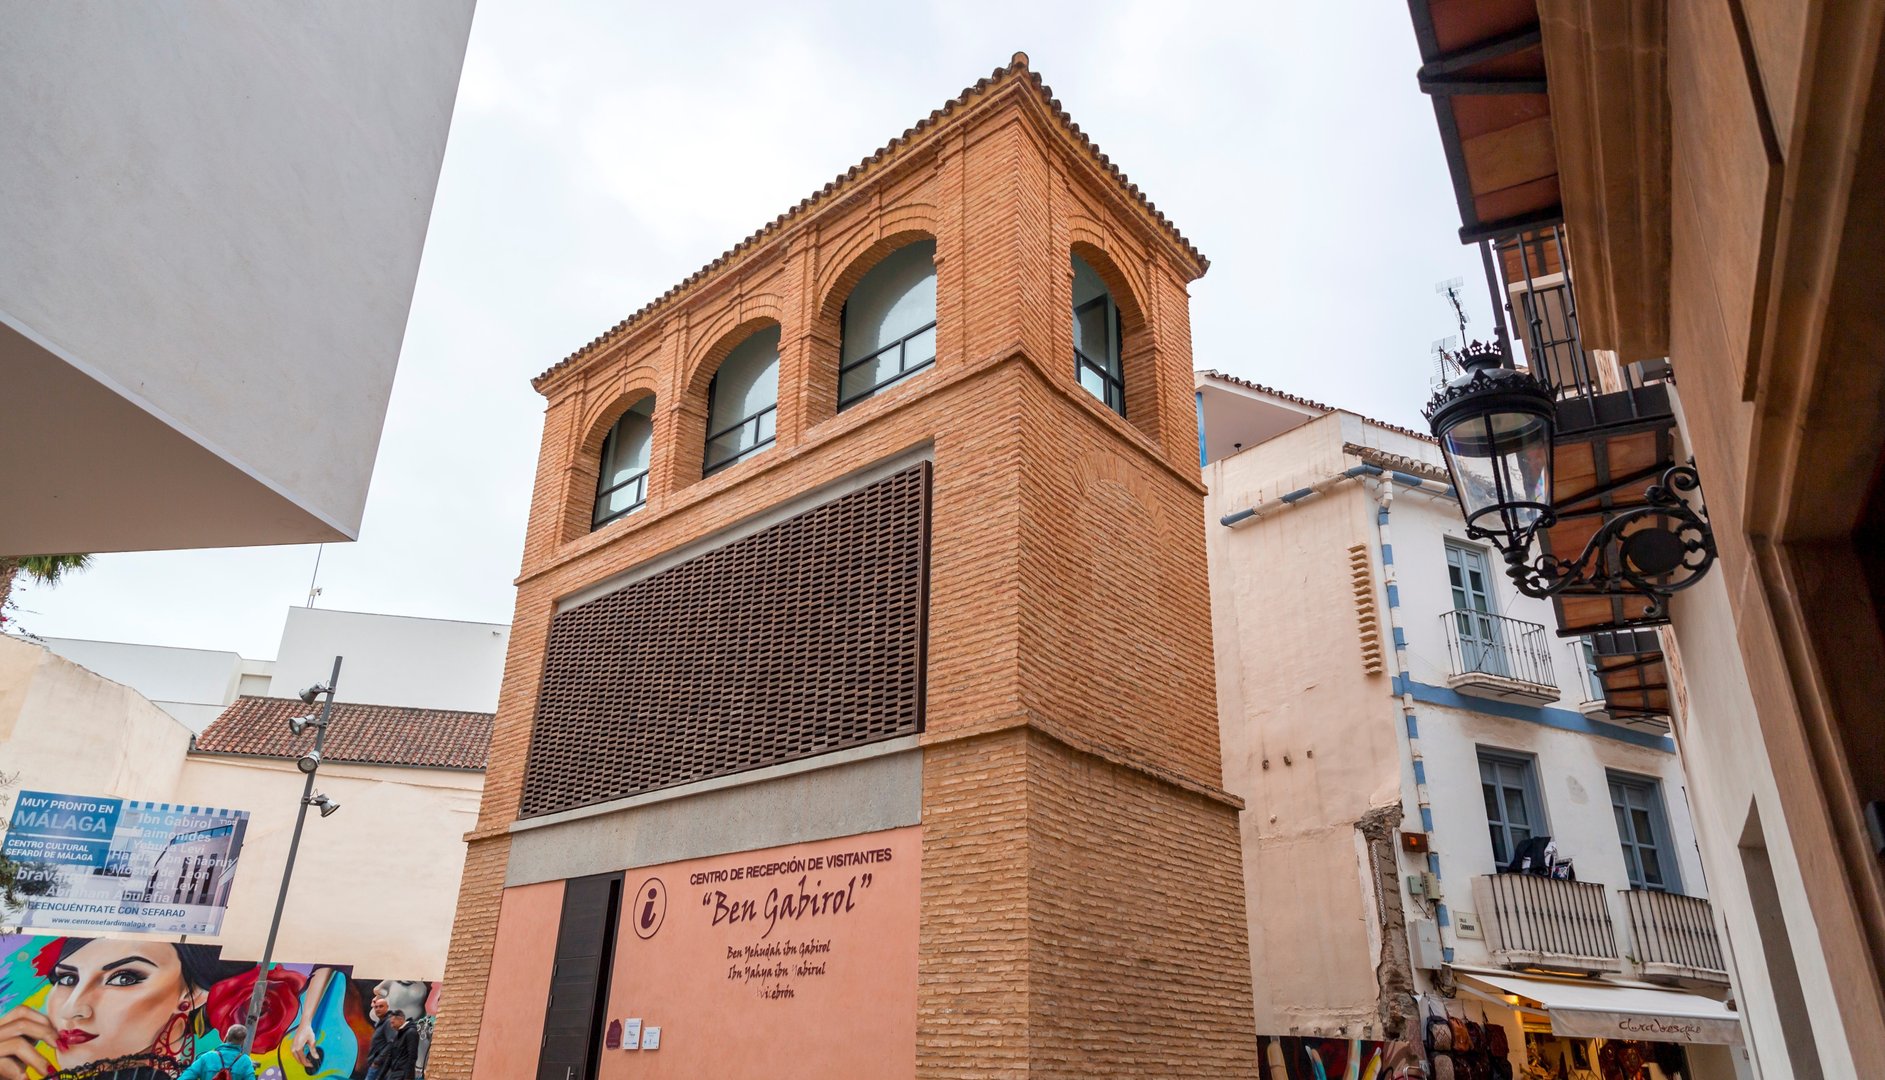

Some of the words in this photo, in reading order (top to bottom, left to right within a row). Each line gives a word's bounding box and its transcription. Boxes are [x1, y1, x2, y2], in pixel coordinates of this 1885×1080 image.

[20, 797, 48, 808] MUY
[50, 799, 97, 813] PRONTO
[98, 804, 114, 814] EN
[14, 808, 107, 833] MÁLAGA
[164, 815, 212, 829] Gabirol
[8, 839, 44, 849] CENTRO
[45, 842, 89, 852] CULTURAL
[5, 847, 43, 857] SEFARDÍ
[44, 851, 55, 859] DE
[57, 851, 93, 861] MÁLAGA
[690, 868, 728, 885] CENTRO
[729, 866, 744, 880] DE
[746, 856, 805, 879] RECEPCIÓN
[807, 856, 824, 871] DE
[826, 847, 893, 868] VISITANTES
[117, 906, 140, 915] CON
[141, 907, 186, 917] SEFARAD
[51, 917, 156, 929] www.centrosefardimalaga.es
[727, 945, 743, 959] Ben
[783, 940, 797, 956] ibn
[799, 938, 831, 958] Gabirol
[727, 964, 742, 981] Ibn
[744, 963, 773, 986] Yahya
[774, 961, 788, 978] ibn
